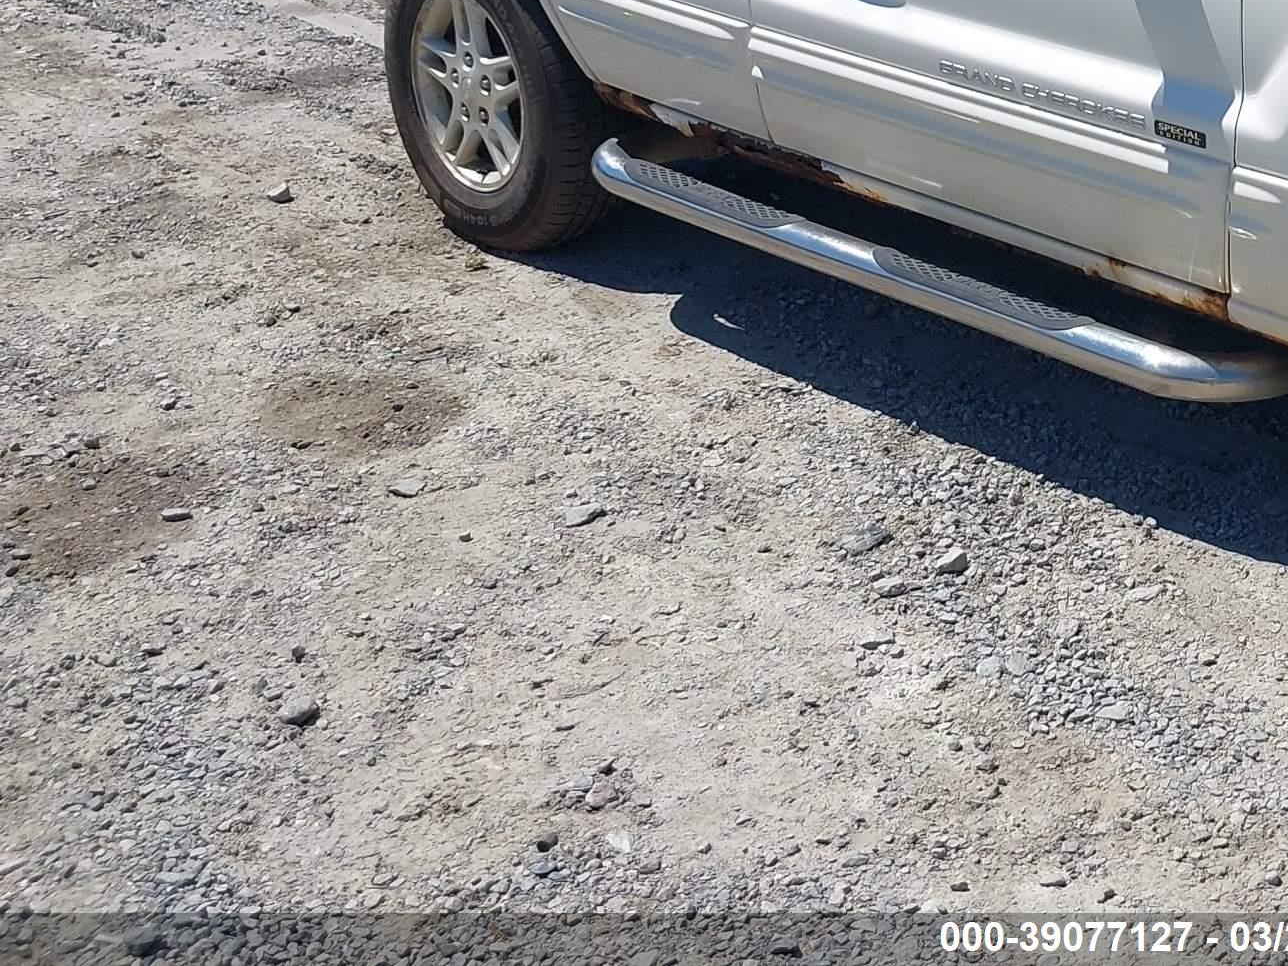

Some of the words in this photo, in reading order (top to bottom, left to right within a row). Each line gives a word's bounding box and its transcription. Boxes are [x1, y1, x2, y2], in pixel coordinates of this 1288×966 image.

[938, 59, 1016, 92] GRAND
[1021, 81, 1146, 129] CHEROKEE
[1158, 122, 1202, 141] SPECIAL
[1159, 130, 1201, 146] EDITION
